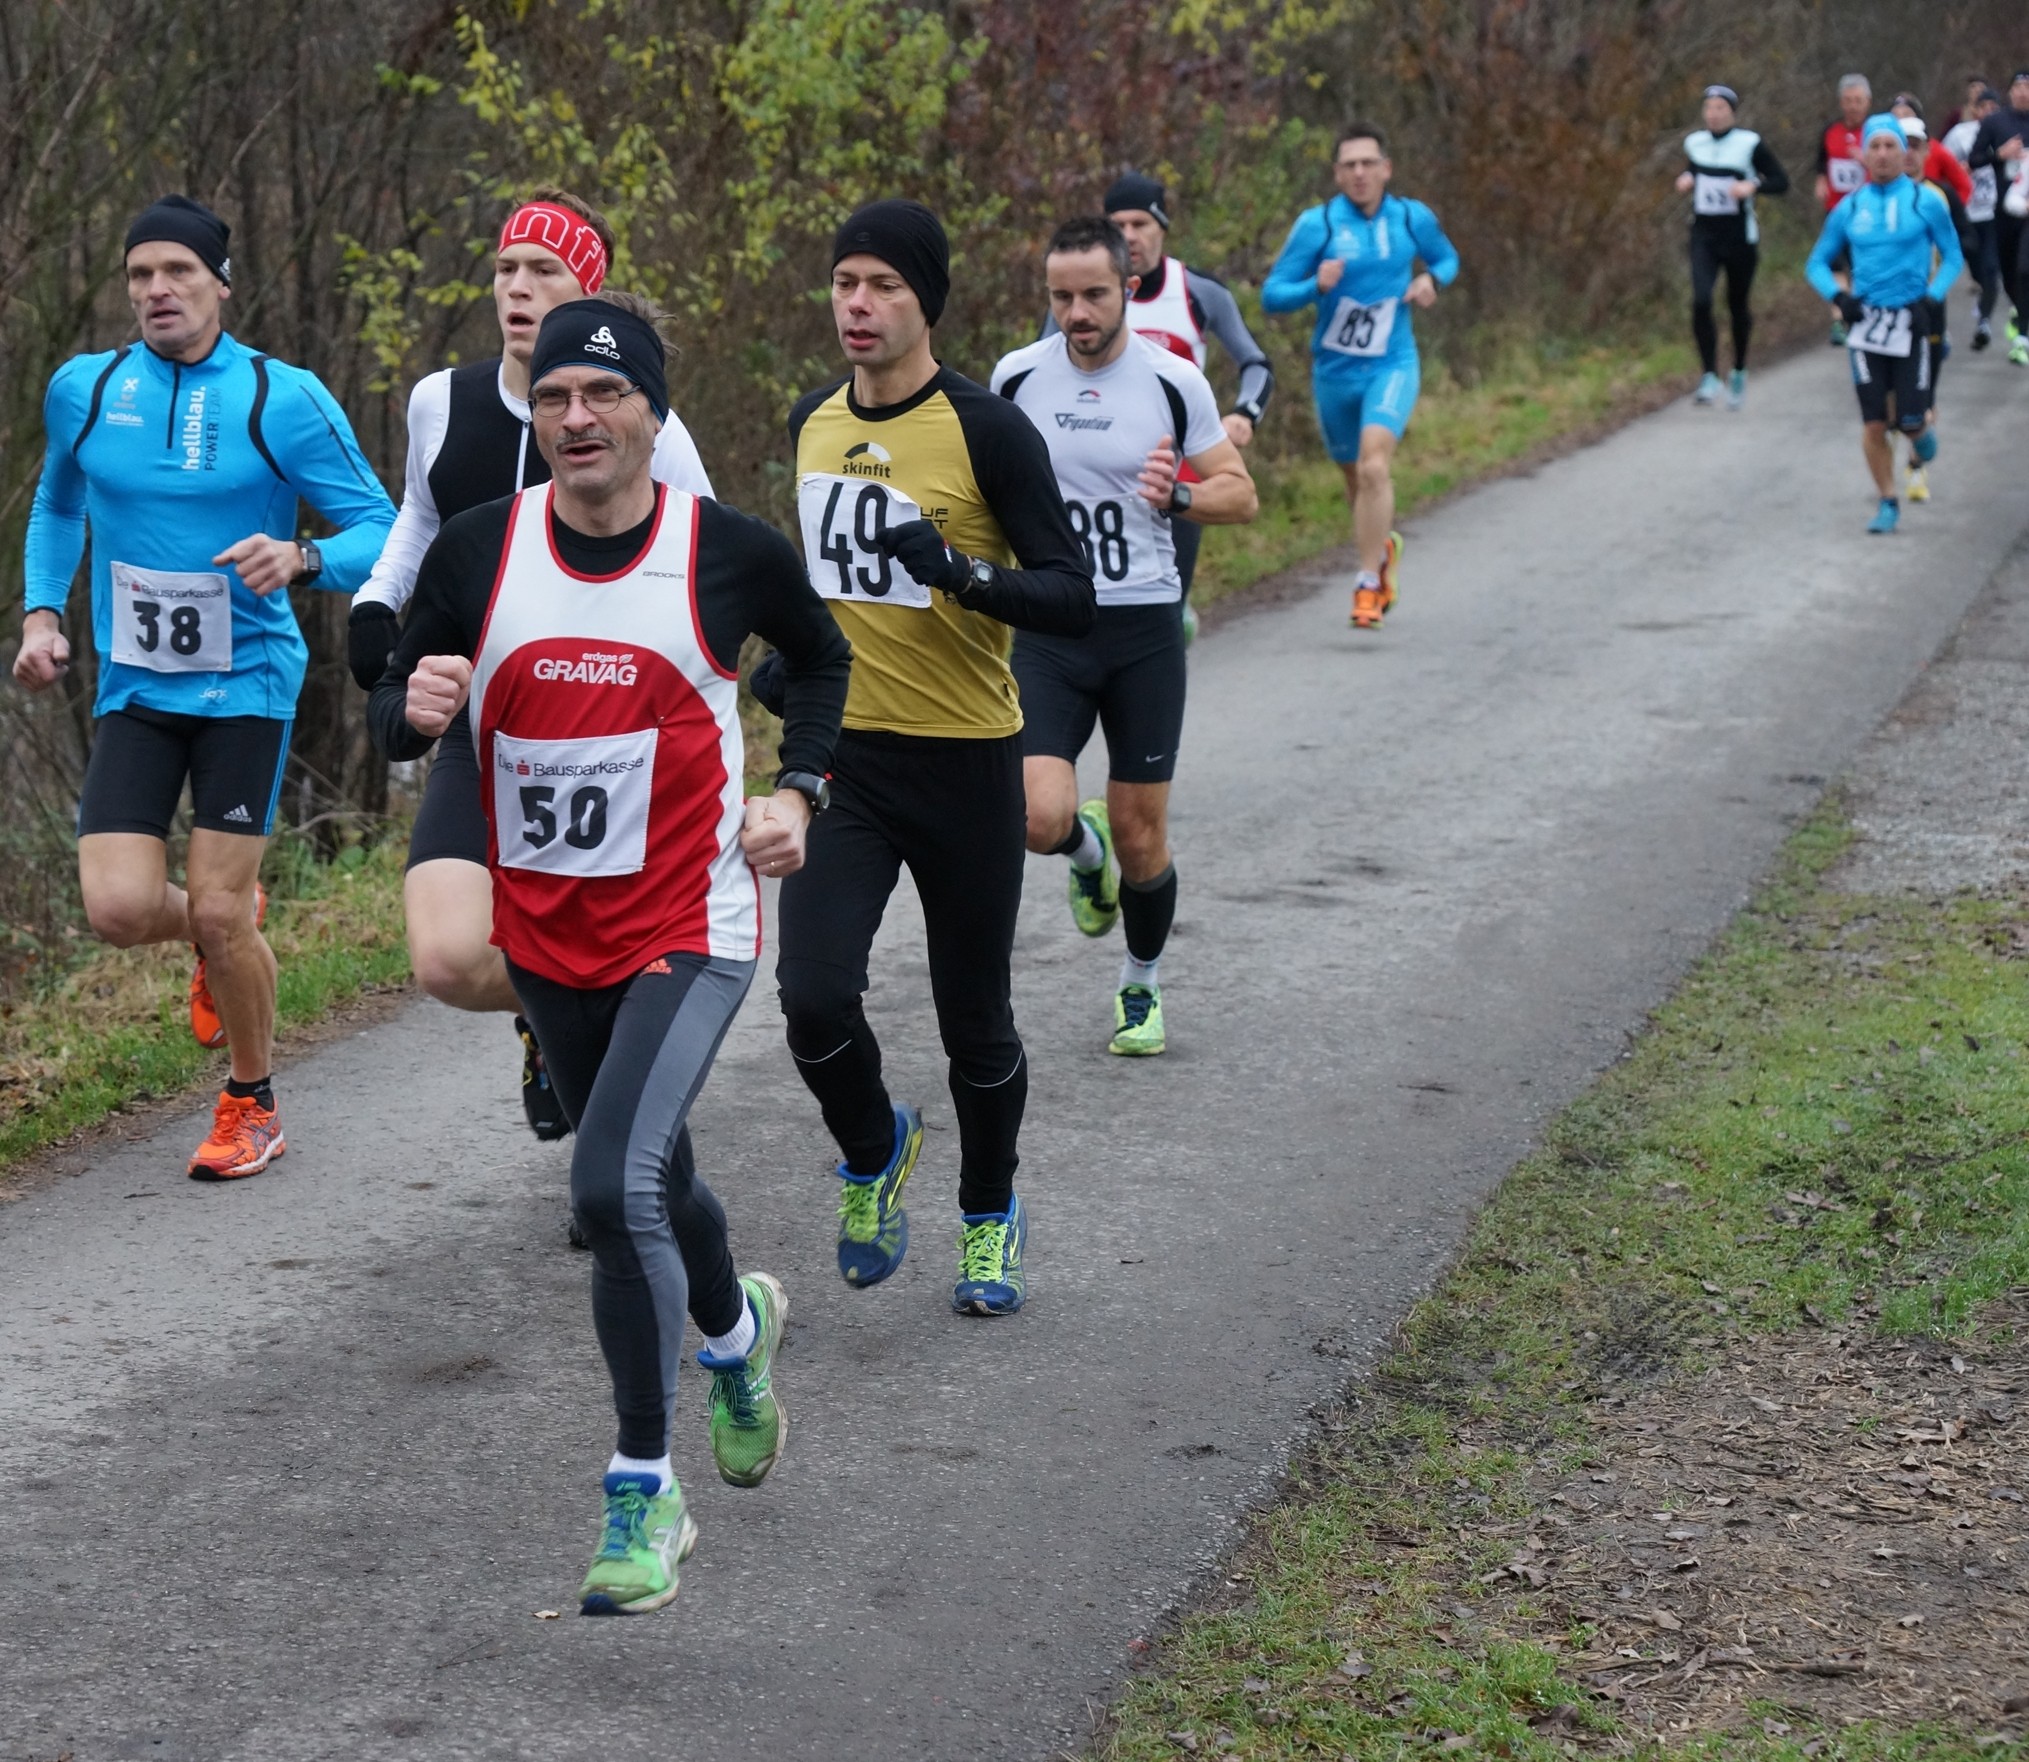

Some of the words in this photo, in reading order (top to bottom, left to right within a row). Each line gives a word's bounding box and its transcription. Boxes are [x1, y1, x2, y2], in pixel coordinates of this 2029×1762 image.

[1338, 307, 1375, 349] 85
[584, 343, 621, 360] odlo
[181, 385, 206, 470] hellblau.
[842, 462, 891, 478] skinfit
[920, 507, 948, 518] UF
[820, 482, 893, 597] 49
[142, 584, 224, 600] Bausparkasse
[132, 599, 202, 655] 38
[582, 652, 618, 663] erdgas
[533, 658, 637, 686] GRAVAG
[534, 756, 644, 779] Bausparkasse
[223, 813, 252, 823] adidas
[519, 785, 608, 850] 50
